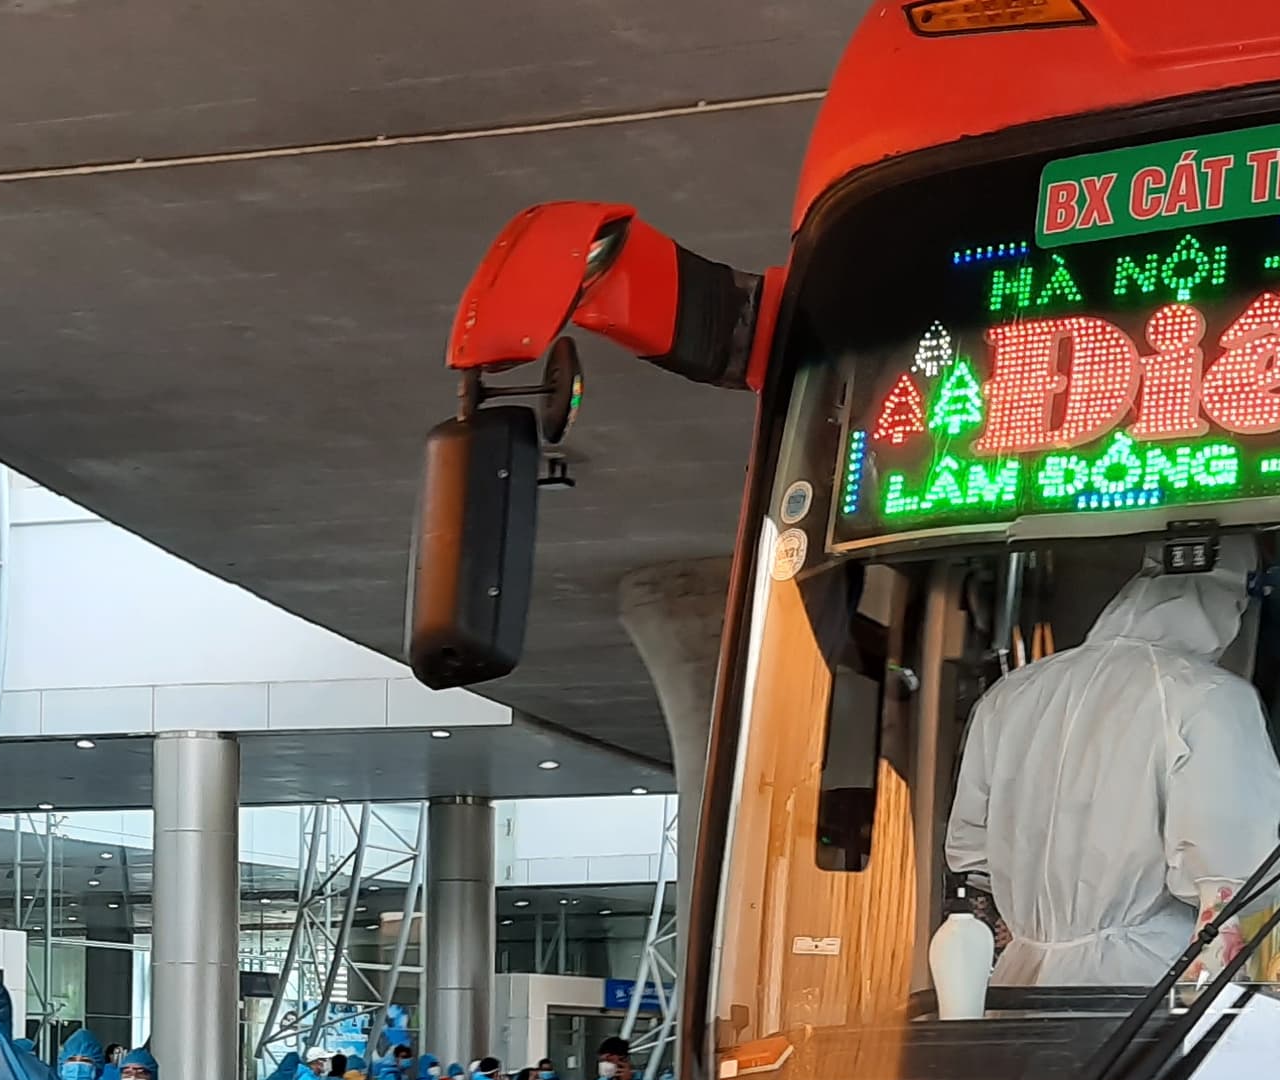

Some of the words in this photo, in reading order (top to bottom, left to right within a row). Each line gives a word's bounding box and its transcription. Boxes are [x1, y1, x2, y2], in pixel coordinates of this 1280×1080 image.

[1044, 174, 1117, 234] BX
[1129, 150, 1233, 220] CÁT
[989, 253, 1082, 311] HÀ
[1113, 234, 1228, 301] NỘI
[885, 456, 1018, 513] LÂM
